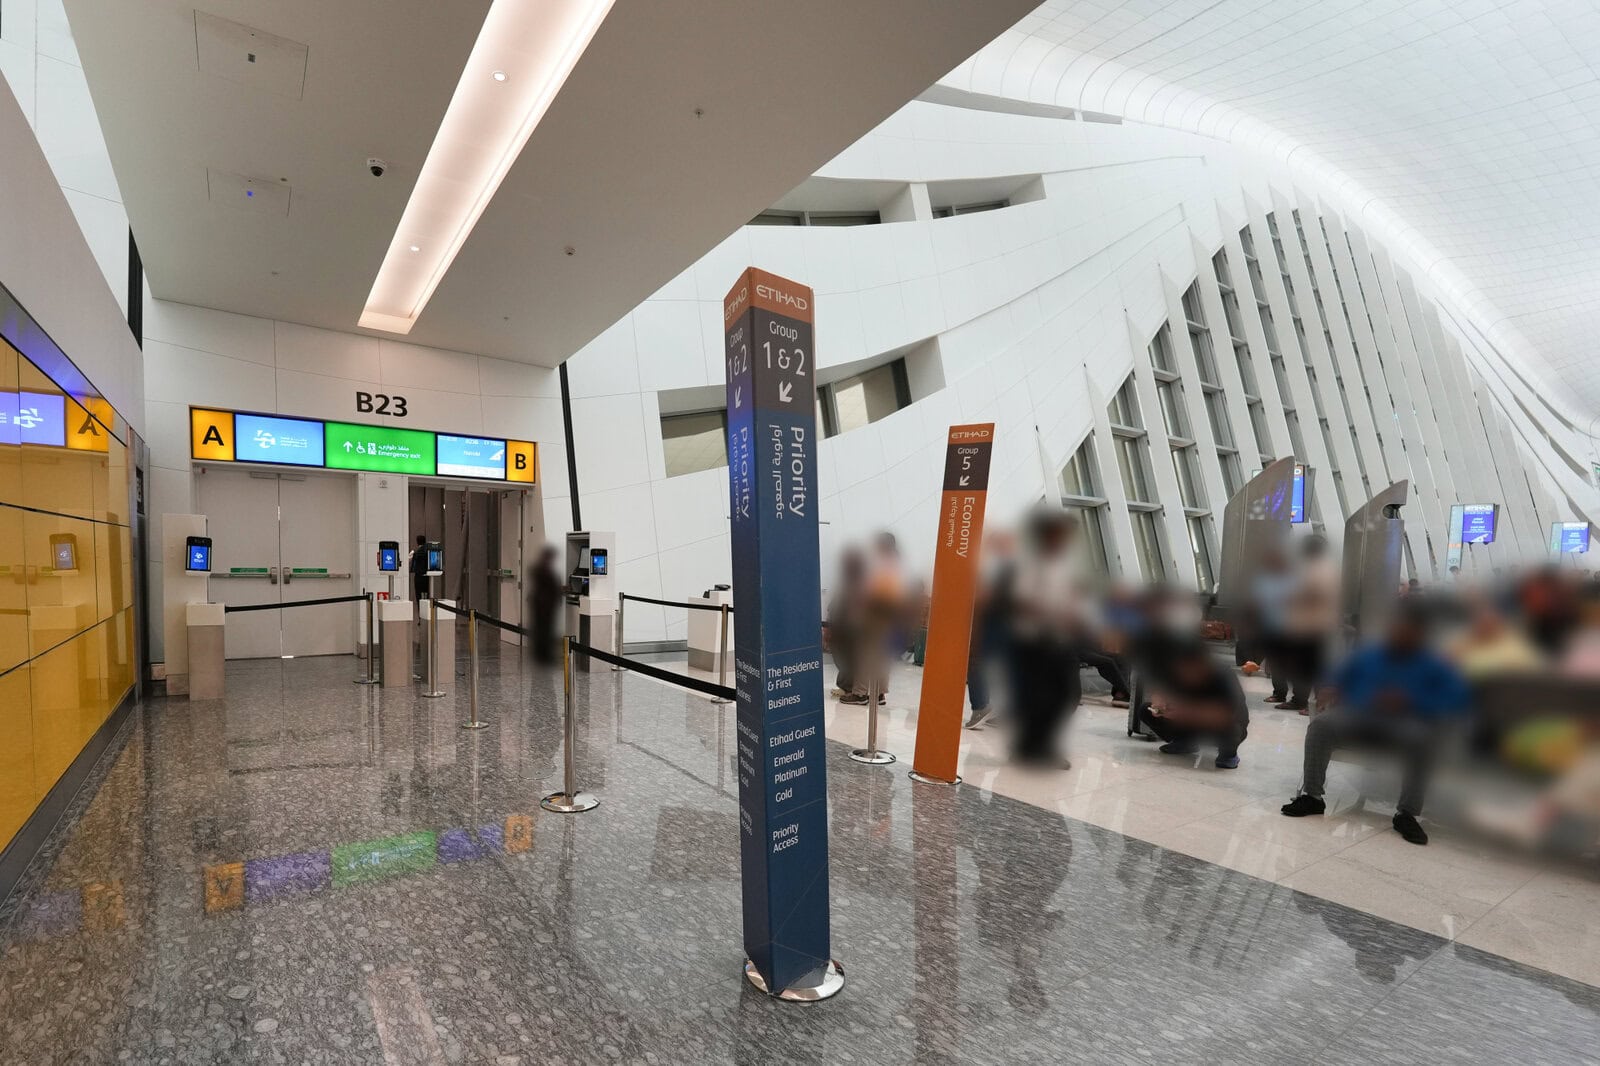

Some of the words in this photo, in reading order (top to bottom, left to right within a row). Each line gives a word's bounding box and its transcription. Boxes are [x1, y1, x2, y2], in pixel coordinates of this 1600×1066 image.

[756, 284, 808, 310] ETIHAD
[769, 321, 798, 342] Group
[356, 391, 408, 417] B23
[202, 425, 225, 447] A
[951, 430, 990, 439] ETIHAD
[378, 450, 409, 459] Emergency
[769, 424, 783, 466] أولوية
[957, 447, 979, 455] Group
[515, 453, 526, 470] B
[961, 456, 972, 471] 5
[740, 426, 750, 518] Priority
[789, 426, 807, 517] Priority
[772, 470, 785, 520] الصعود
[956, 496, 975, 558] Economy
[767, 667, 782, 678] The
[783, 660, 820, 675] Residence
[767, 681, 774, 692] &
[775, 678, 792, 690] First
[768, 694, 801, 710] Business
[769, 730, 794, 747] Etihad
[794, 726, 816, 740] Guest
[774, 748, 805, 767] Emerald
[774, 765, 808, 784] Platinum
[775, 787, 793, 803] Gold
[772, 823, 799, 841] Priority
[773, 835, 799, 853] Access
